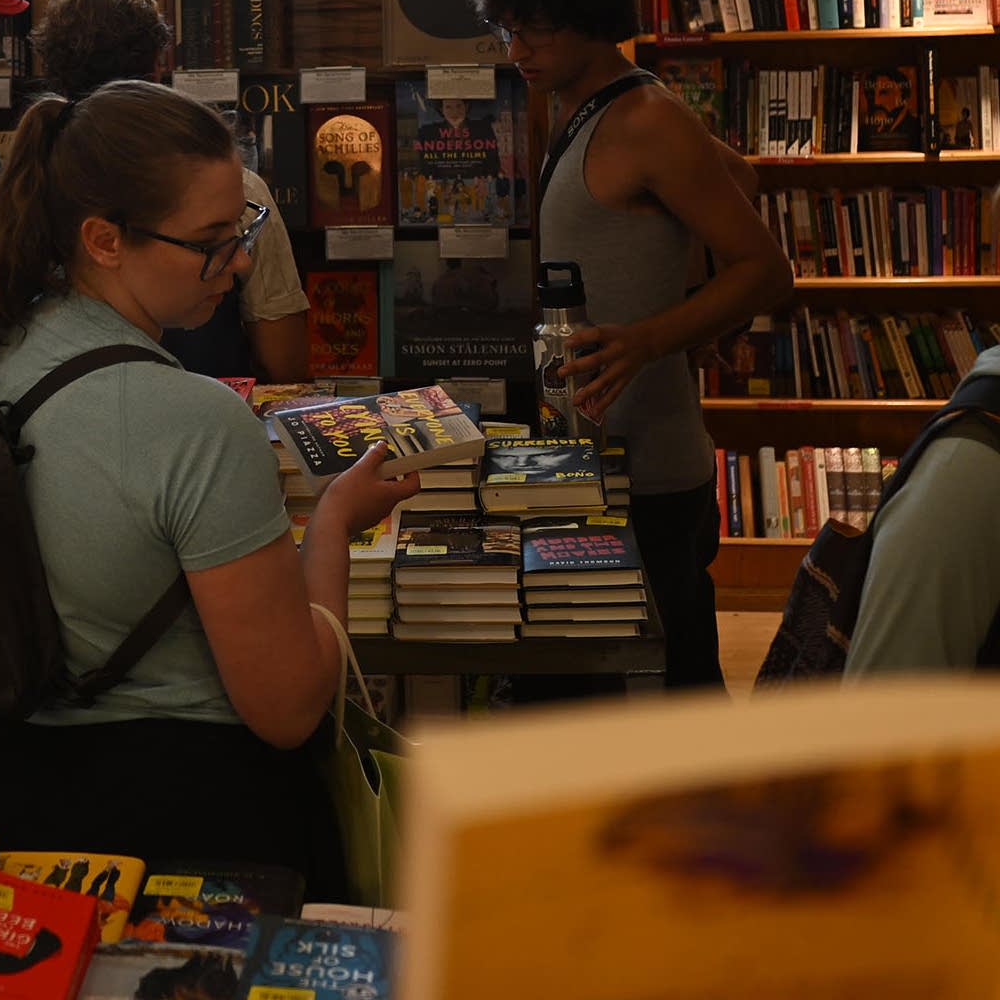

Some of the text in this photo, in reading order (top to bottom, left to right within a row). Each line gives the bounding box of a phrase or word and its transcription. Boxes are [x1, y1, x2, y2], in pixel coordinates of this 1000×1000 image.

[567, 98, 597, 139] SONY
[319, 131, 376, 144] SONG OF
[438, 127, 471, 139] WES
[317, 142, 381, 155] ACHILLES
[412, 139, 497, 151] ANDERSON
[423, 152, 439, 161] ALL
[461, 151, 488, 161] FILMS
[401, 343, 452, 355] SIMON
[483, 358, 508, 368] POINT
[312, 410, 338, 428] TO
[398, 391, 455, 446] EVERYONE
[394, 422, 417, 437] IS
[287, 416, 323, 468] JO PIAZZA
[322, 430, 358, 459] YOU
[486, 436, 595, 449] SURRENDER
[554, 471, 595, 480] BONO
[297, 939, 357, 959] SILK
[316, 955, 342, 967] OF
[271, 960, 375, 983] HOUSE
